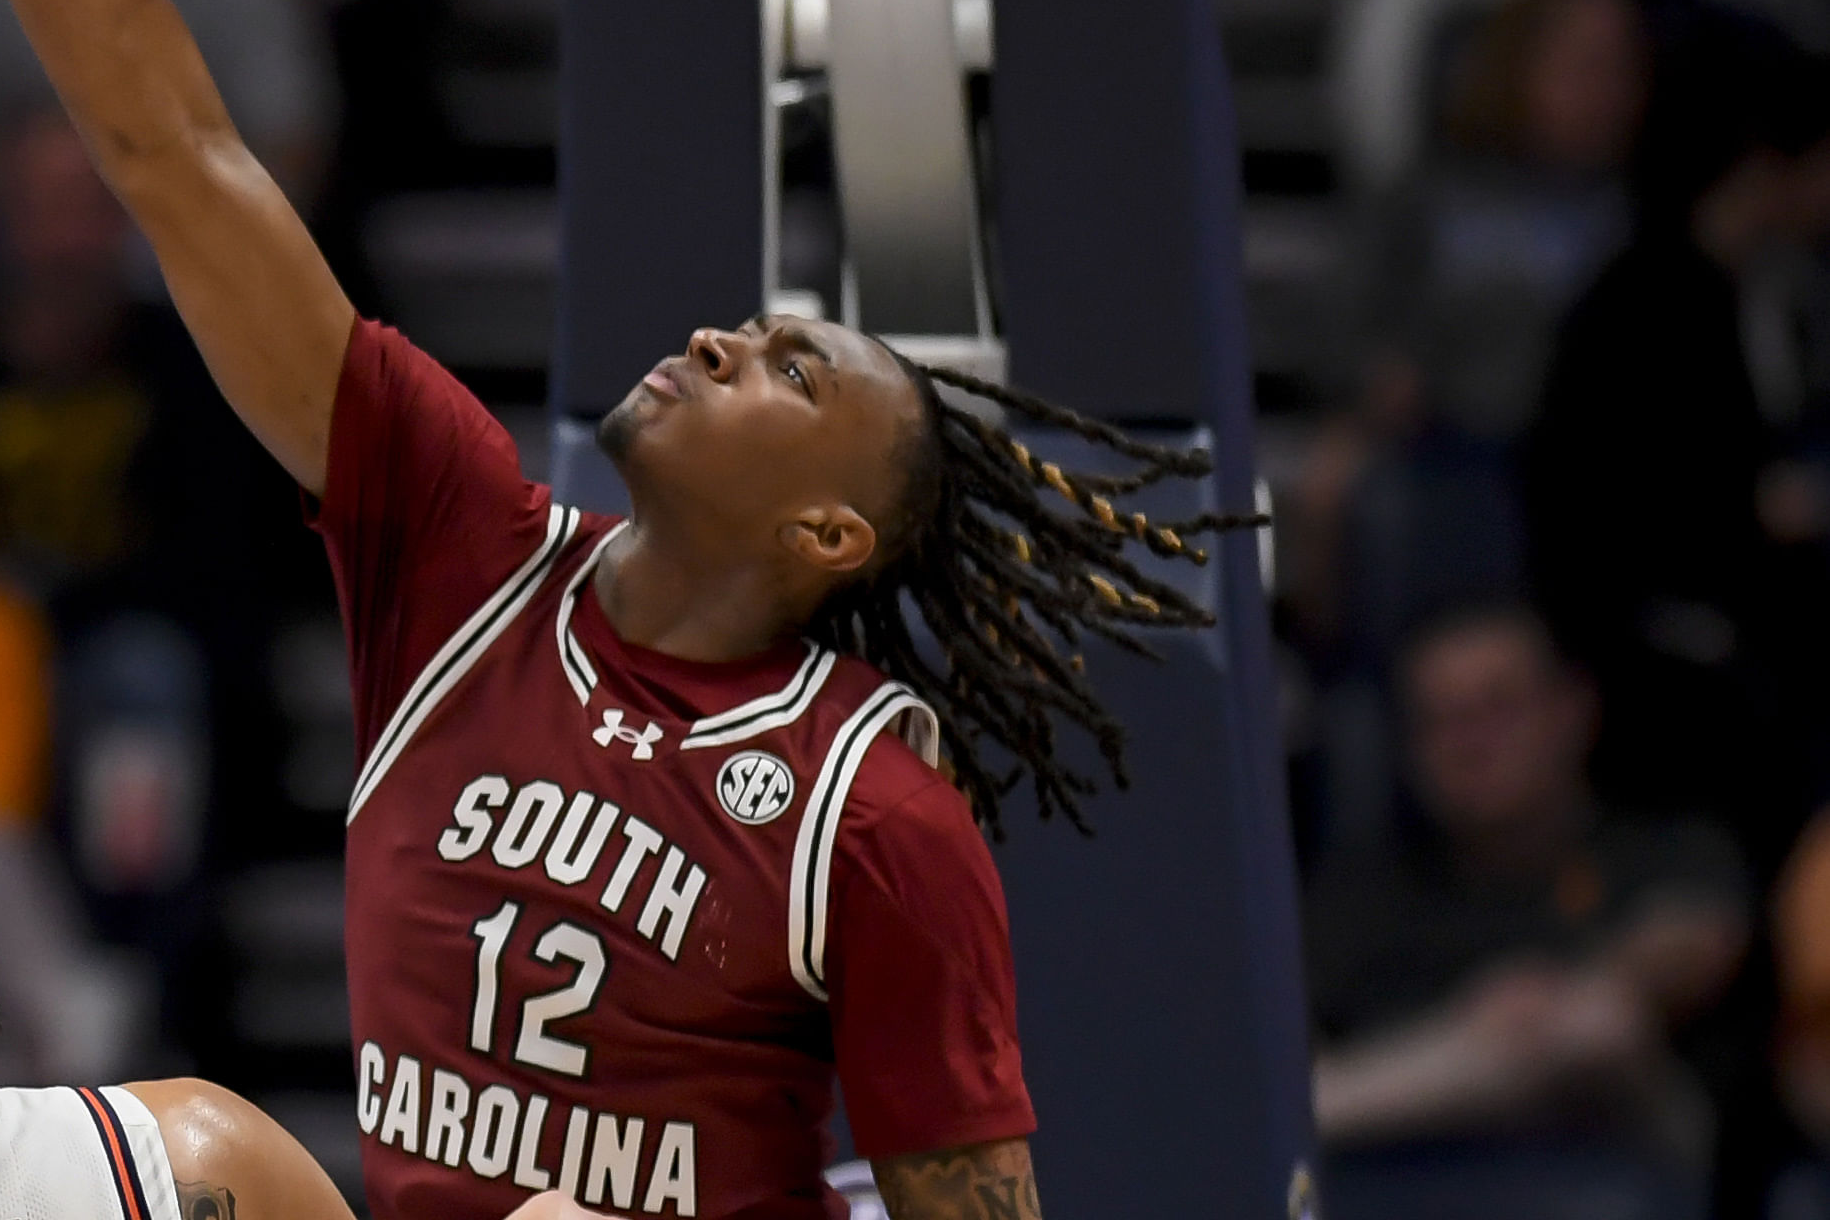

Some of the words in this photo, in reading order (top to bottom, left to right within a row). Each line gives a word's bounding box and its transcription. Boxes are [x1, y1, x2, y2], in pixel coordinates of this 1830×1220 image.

[438, 774, 707, 961] SOUTH
[720, 755, 790, 818] SEC
[471, 900, 607, 1077] 12
[356, 1040, 698, 1218] CAROLINA
